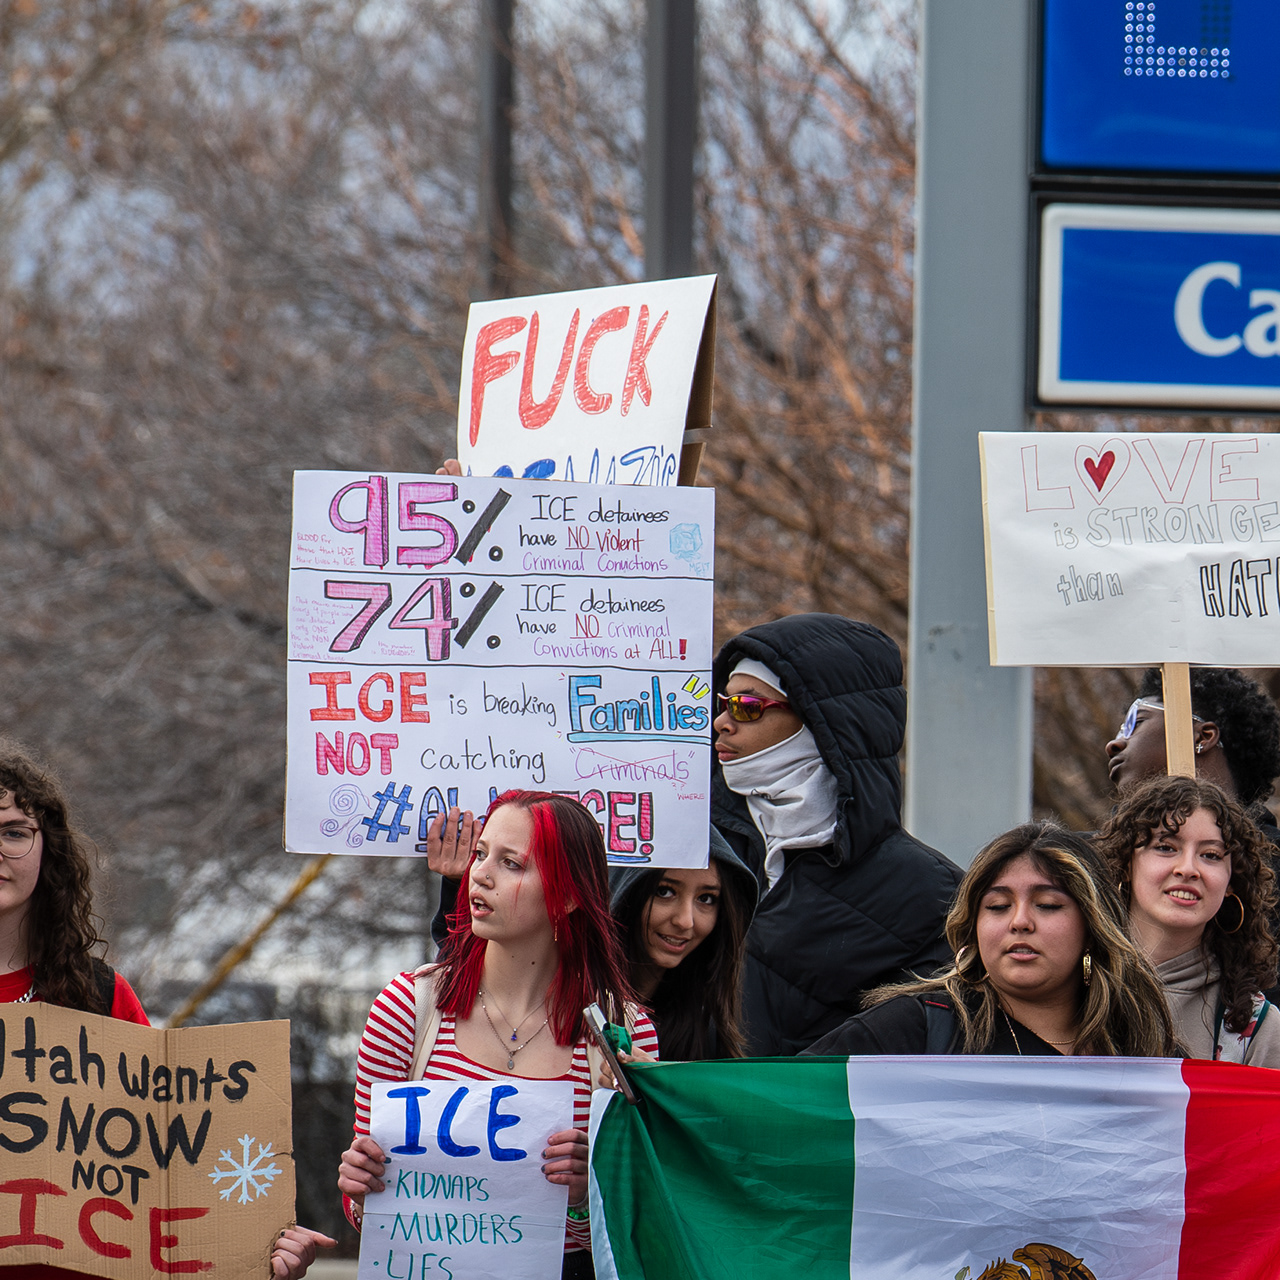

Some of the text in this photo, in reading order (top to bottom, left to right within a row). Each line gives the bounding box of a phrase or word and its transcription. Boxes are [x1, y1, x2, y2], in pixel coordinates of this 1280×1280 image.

[469, 304, 669, 448] FUCK
[329, 475, 512, 568] 95%
[530, 494, 670, 524] ICE detainees
[337, 547, 354, 556] LOST
[519, 524, 645, 552] have NO Violent
[1053, 522, 1079, 550] is
[522, 551, 668, 572] Criminal Convictions
[520, 583, 666, 614] ICE detainees
[1057, 565, 1123, 605] than
[324, 577, 505, 661] 74%
[516, 614, 557, 634] have
[575, 613, 600, 638] NO
[533, 637, 688, 661] Convictions at ALL!
[308, 671, 709, 732] ICE is breaking Families
[315, 730, 399, 776] NOT
[420, 735, 546, 784] catching
[677, 792, 705, 801] WHERE
[0, 1016, 105, 1090] tah
[0, 1091, 212, 1170] SNOW
[387, 1084, 528, 1162] ICE
[72, 1160, 149, 1205] NOT
[395, 1168, 490, 1202] KIDNAPS
[0, 1178, 216, 1274] ICE
[390, 1212, 524, 1245] MURDERS
